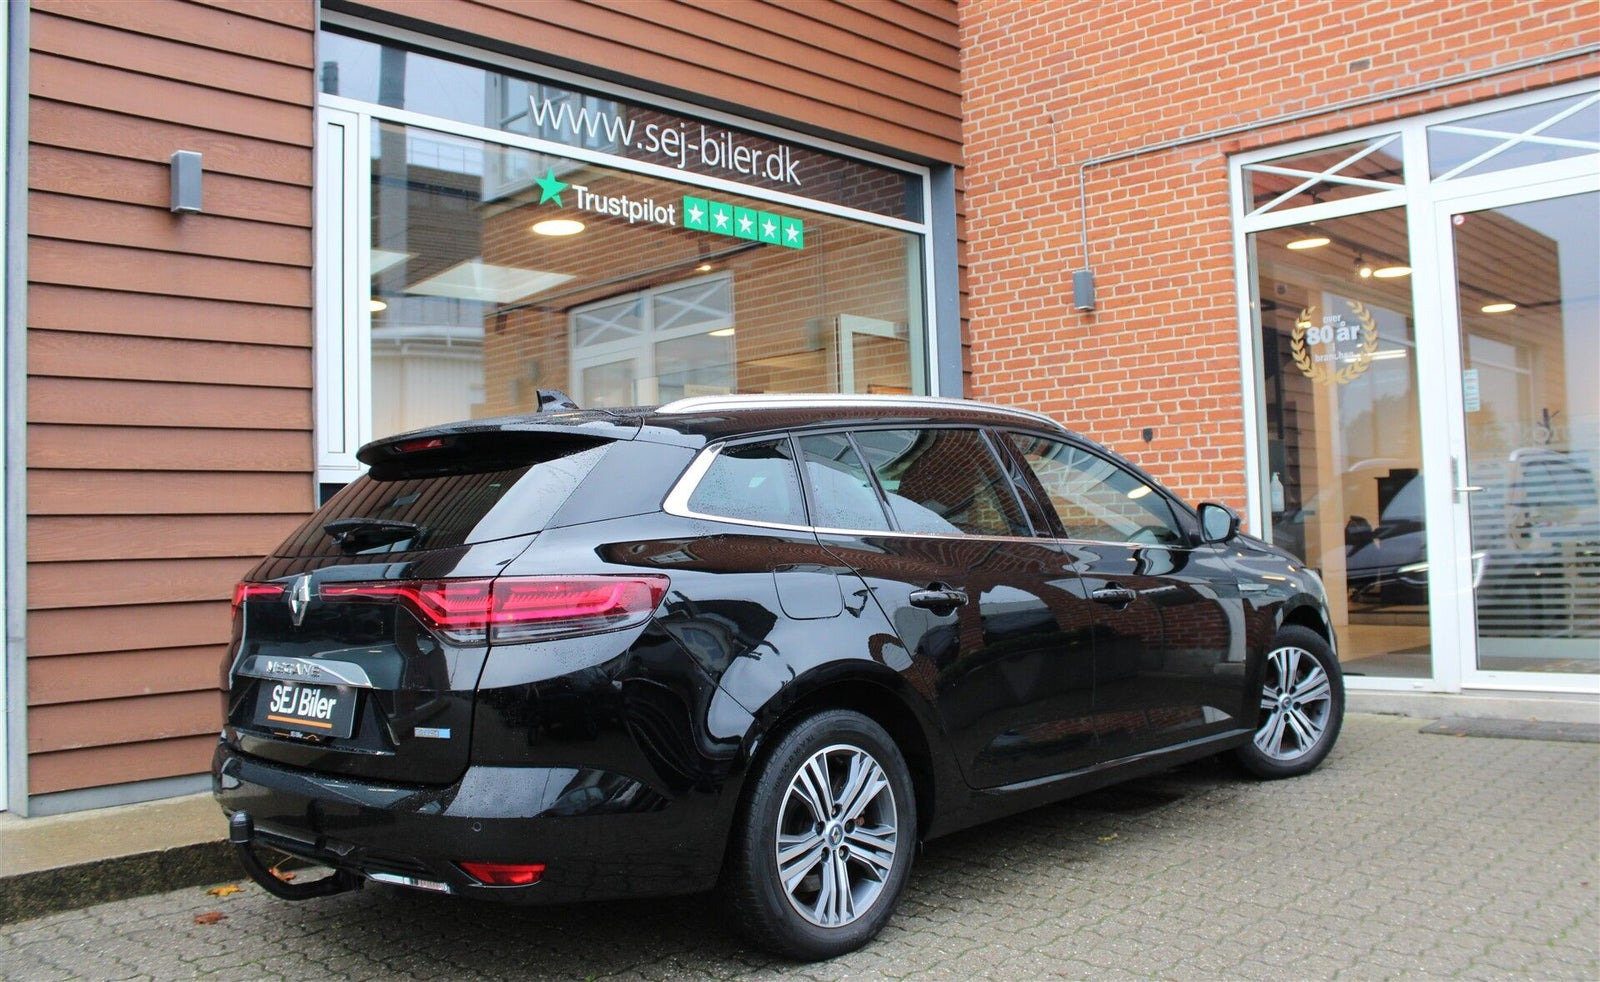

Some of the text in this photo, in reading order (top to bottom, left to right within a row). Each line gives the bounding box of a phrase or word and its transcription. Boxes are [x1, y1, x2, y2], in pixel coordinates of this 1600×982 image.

[529, 95, 801, 185] www.sej-biler.dk
[572, 185, 676, 226] Trustpilot
[1306, 321, 1360, 345] 80 år
[270, 684, 336, 719] SEJ Biler
